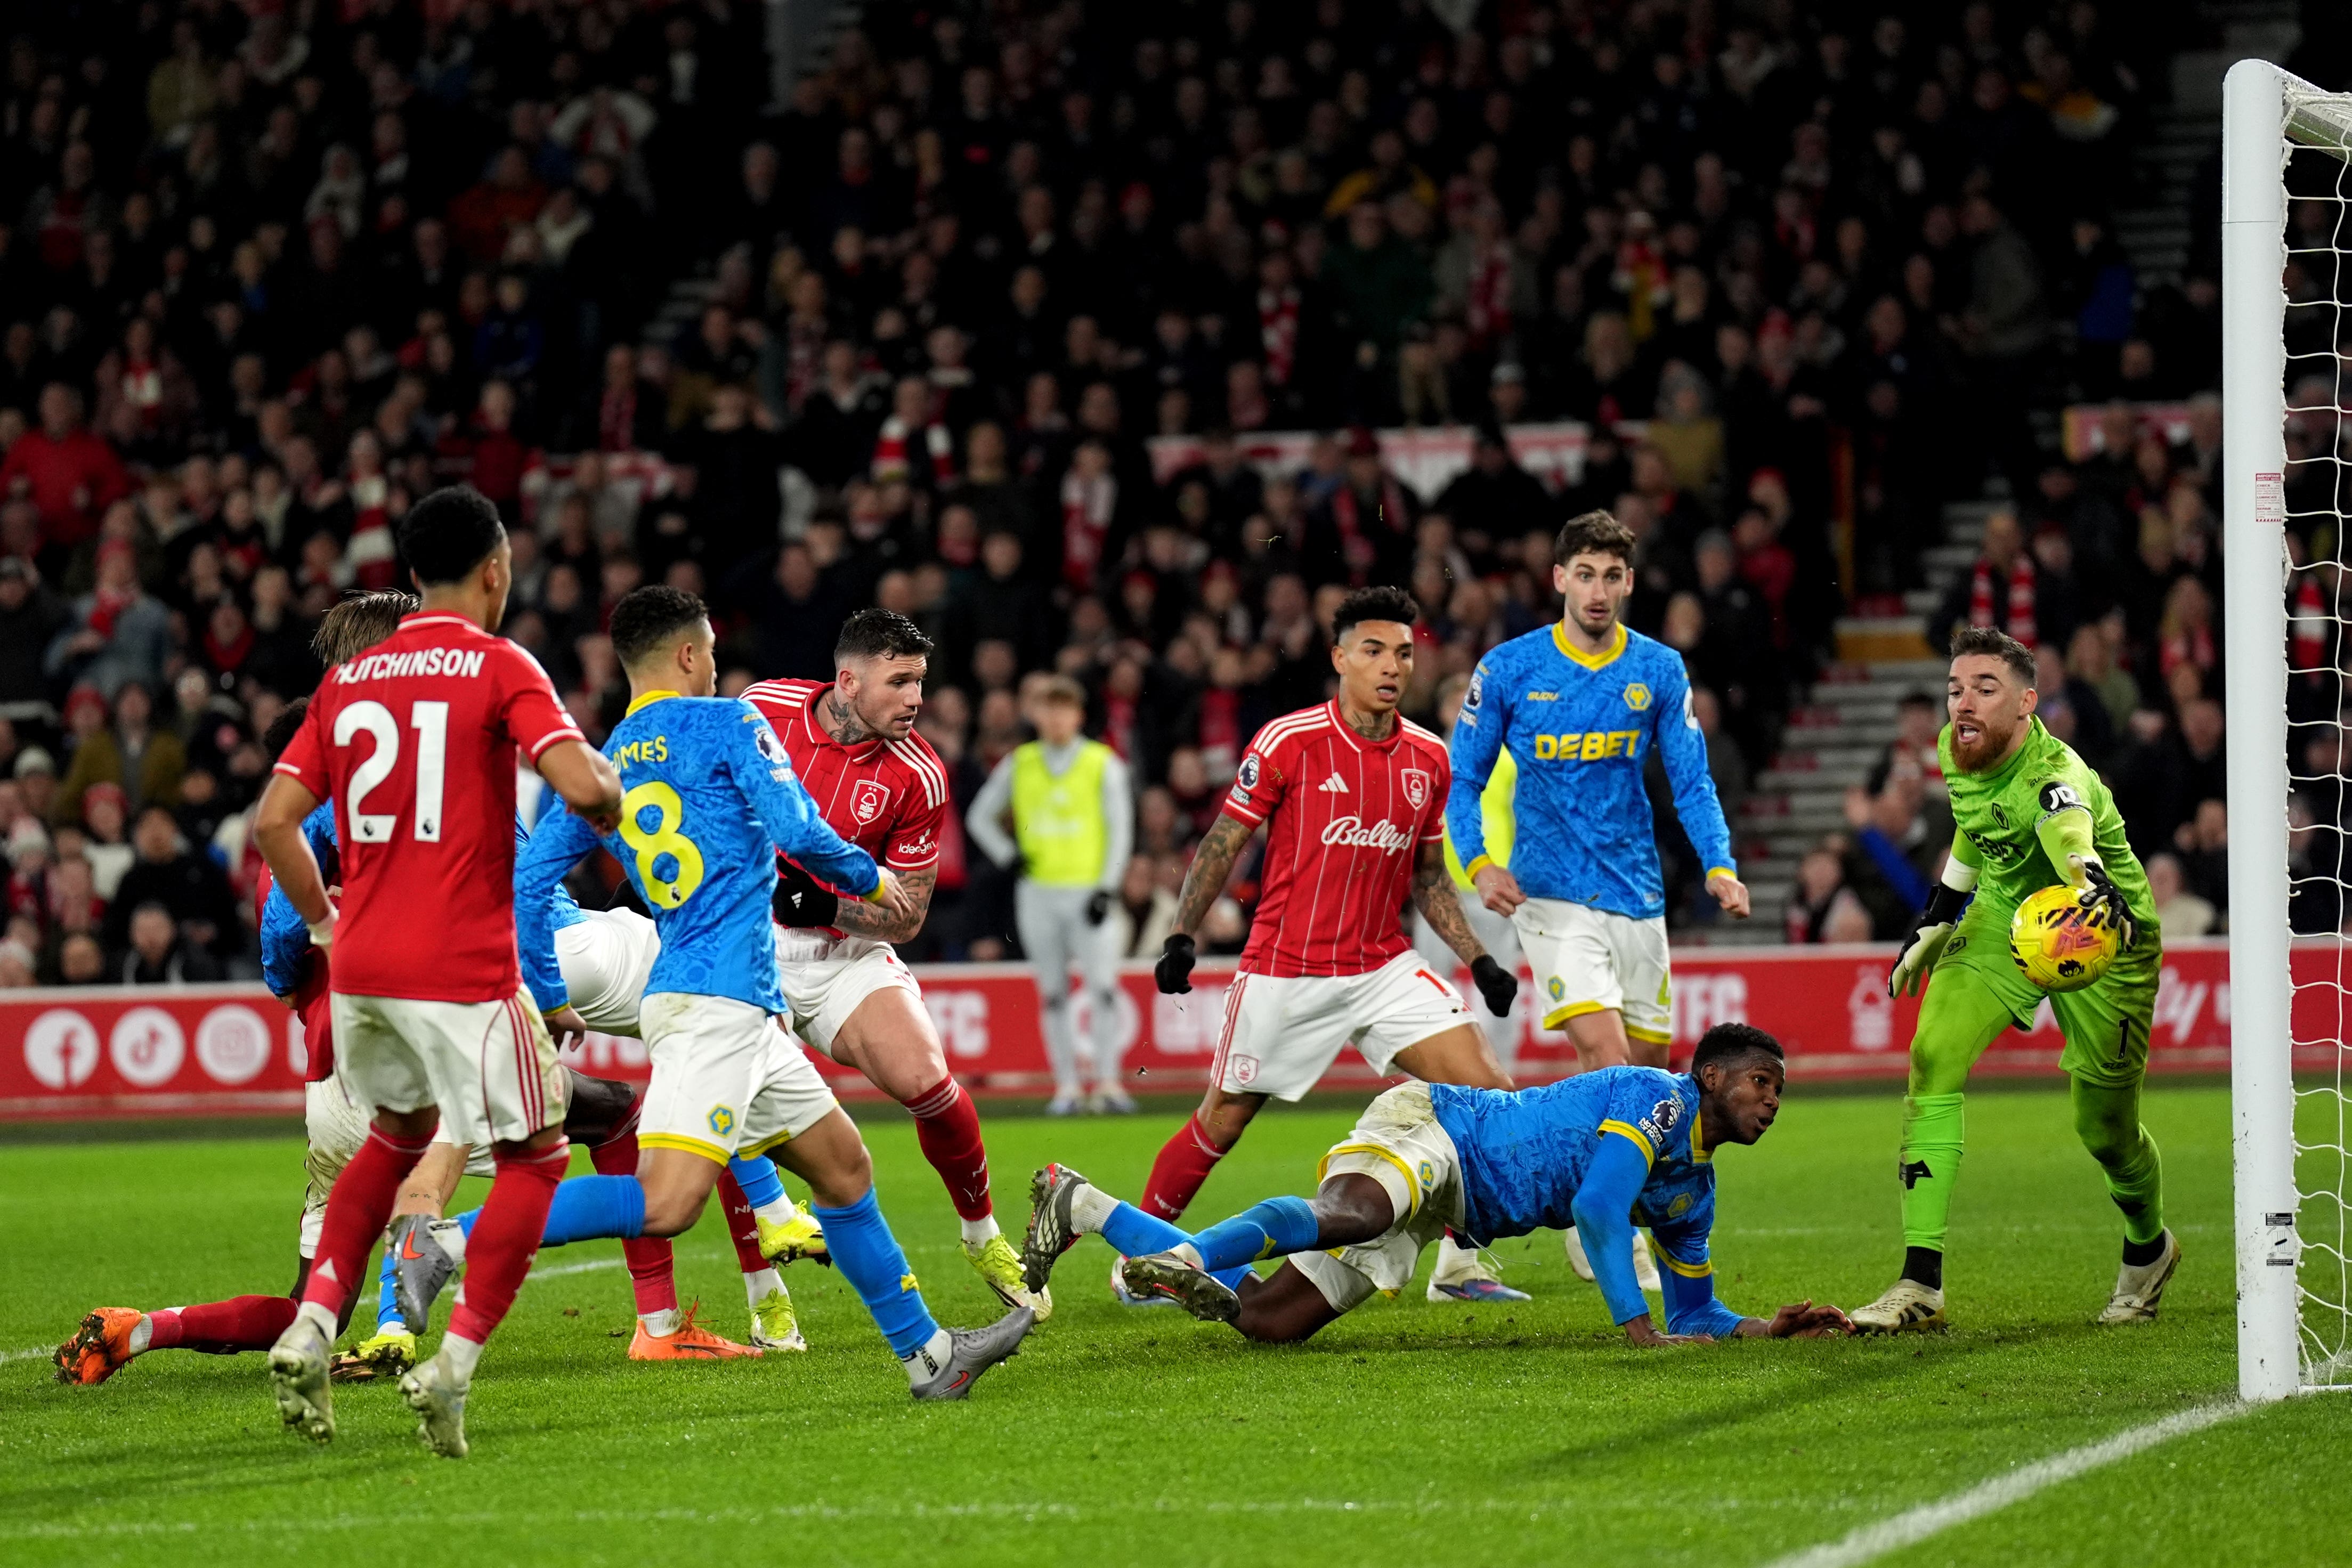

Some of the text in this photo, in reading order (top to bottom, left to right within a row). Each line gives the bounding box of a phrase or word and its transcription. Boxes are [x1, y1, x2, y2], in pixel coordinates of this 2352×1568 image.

[331, 647, 484, 685] HUTCHINSON
[610, 735, 668, 776] OMES
[1534, 729, 1641, 761] DEBET
[334, 700, 449, 842] 21
[2048, 786, 2077, 810] JD
[617, 780, 704, 909] 8
[1320, 815, 1414, 857] Bally's
[1414, 969, 1450, 997] 1
[2118, 1017, 2129, 1059] 1
